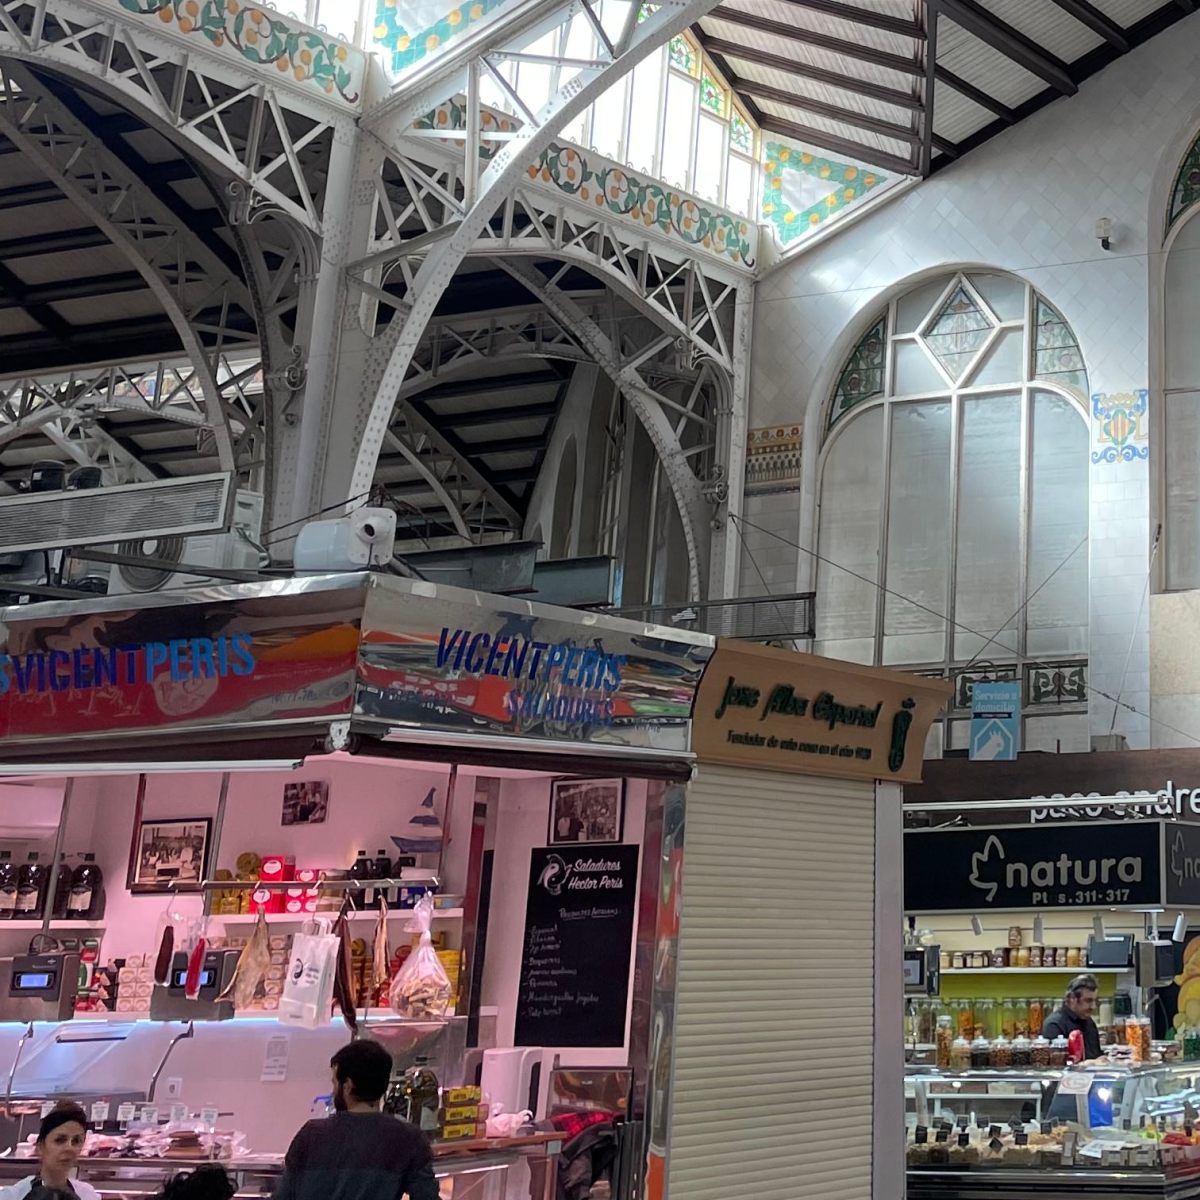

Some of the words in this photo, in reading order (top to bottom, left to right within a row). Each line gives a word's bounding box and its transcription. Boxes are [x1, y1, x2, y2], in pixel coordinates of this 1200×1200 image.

[573, 858, 621, 872] Saladures
[1006, 852, 1143, 889] natura
[567, 876, 598, 890] Hector
[599, 875, 624, 889] Peris
